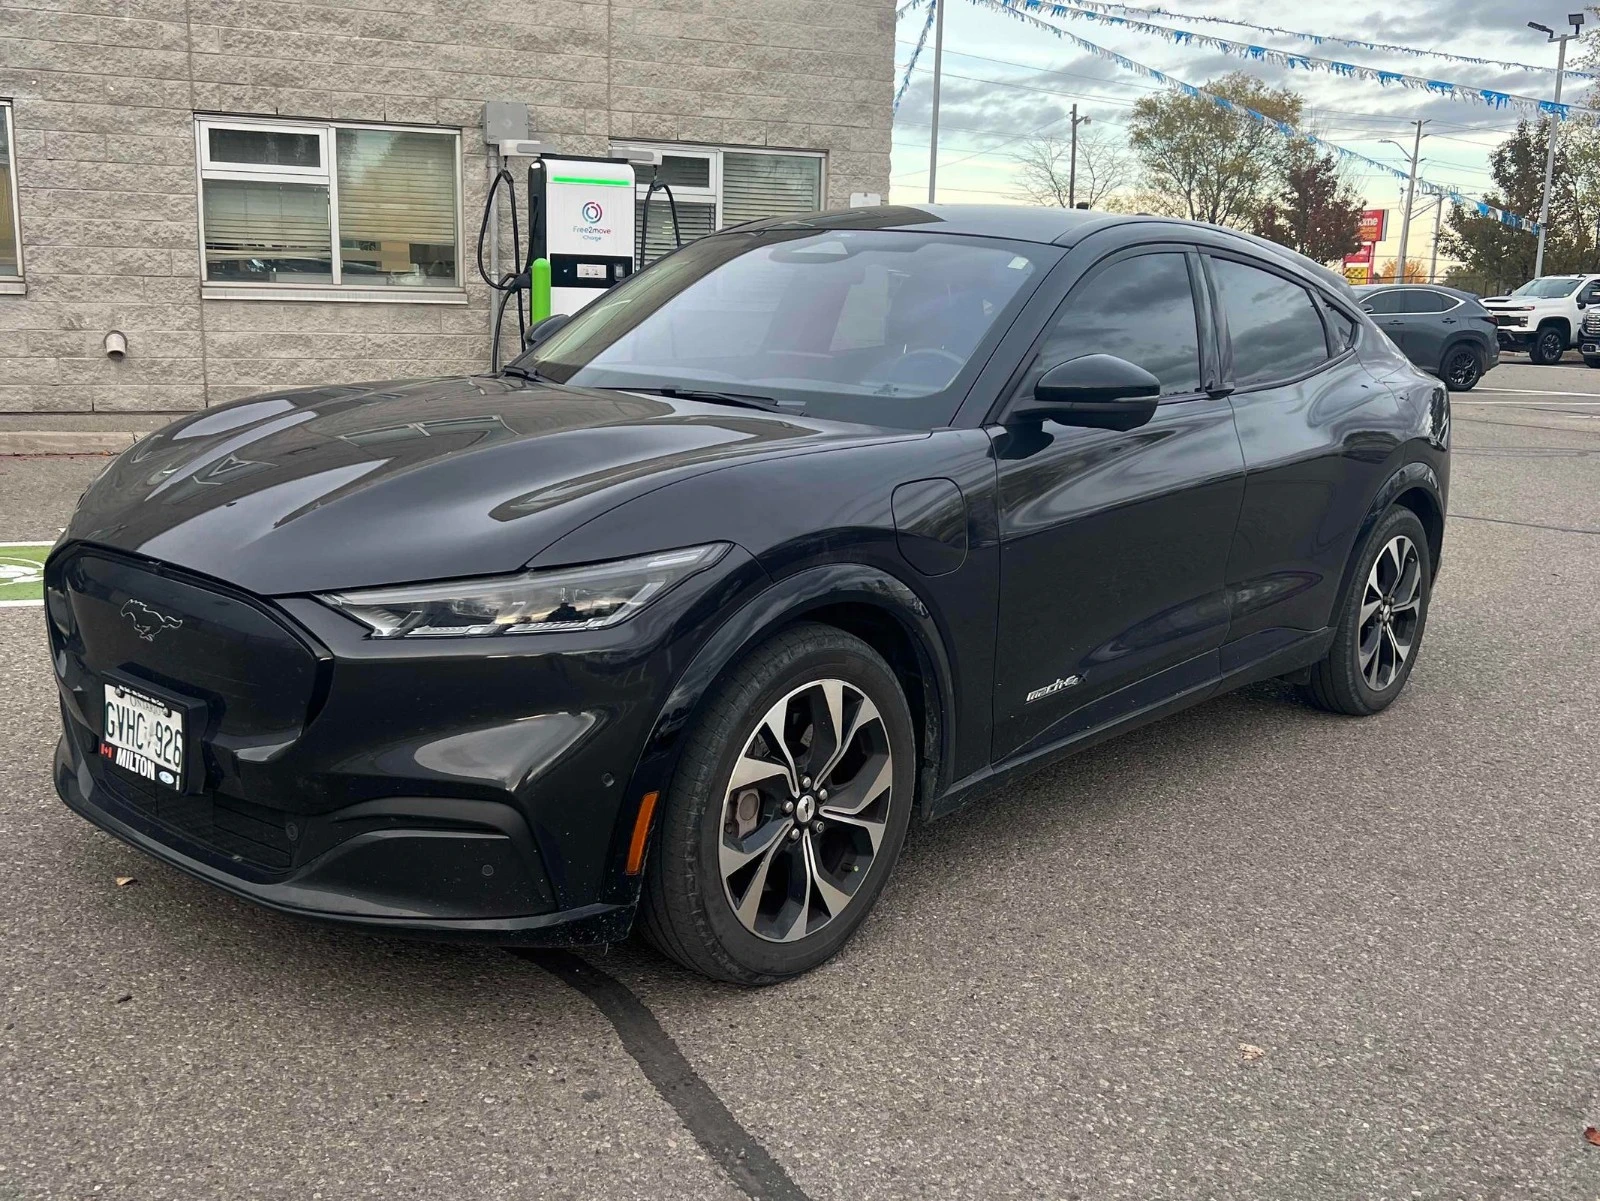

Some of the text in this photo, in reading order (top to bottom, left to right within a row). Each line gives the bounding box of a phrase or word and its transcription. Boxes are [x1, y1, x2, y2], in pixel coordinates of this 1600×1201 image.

[573, 225, 611, 234] Free2move
[105, 701, 182, 768] GVHC 926
[116, 747, 156, 780] MILTON
